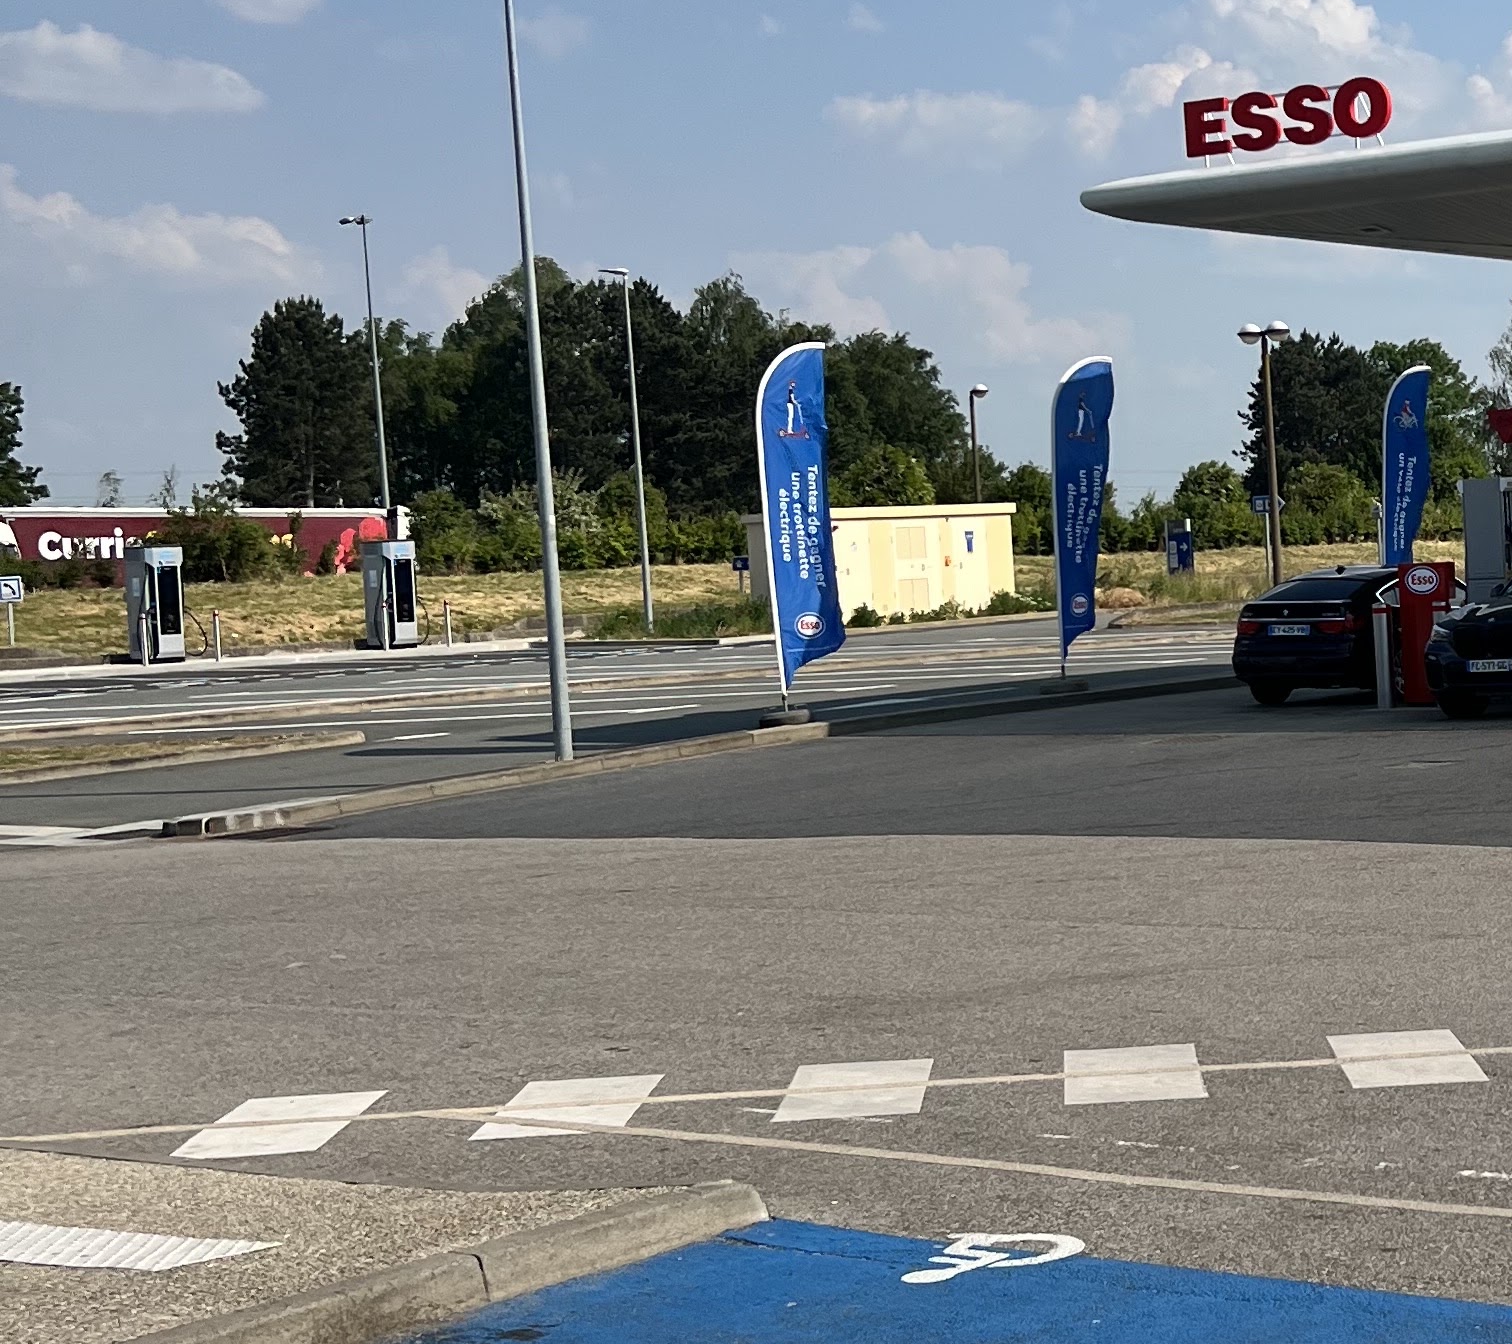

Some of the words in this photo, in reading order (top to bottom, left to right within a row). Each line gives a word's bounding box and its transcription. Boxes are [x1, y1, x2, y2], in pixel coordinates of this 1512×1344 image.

[1183, 76, 1392, 158] ESSO
[791, 472, 801, 500] une
[807, 464, 818, 513] Tentez
[1079, 469, 1087, 494] une
[778, 488, 794, 562] électrique
[793, 503, 810, 580] trottinette
[807, 516, 821, 535] de
[804, 535, 827, 588] gagner
[1410, 573, 1435, 586] Esso
[800, 619, 821, 630] Esso
